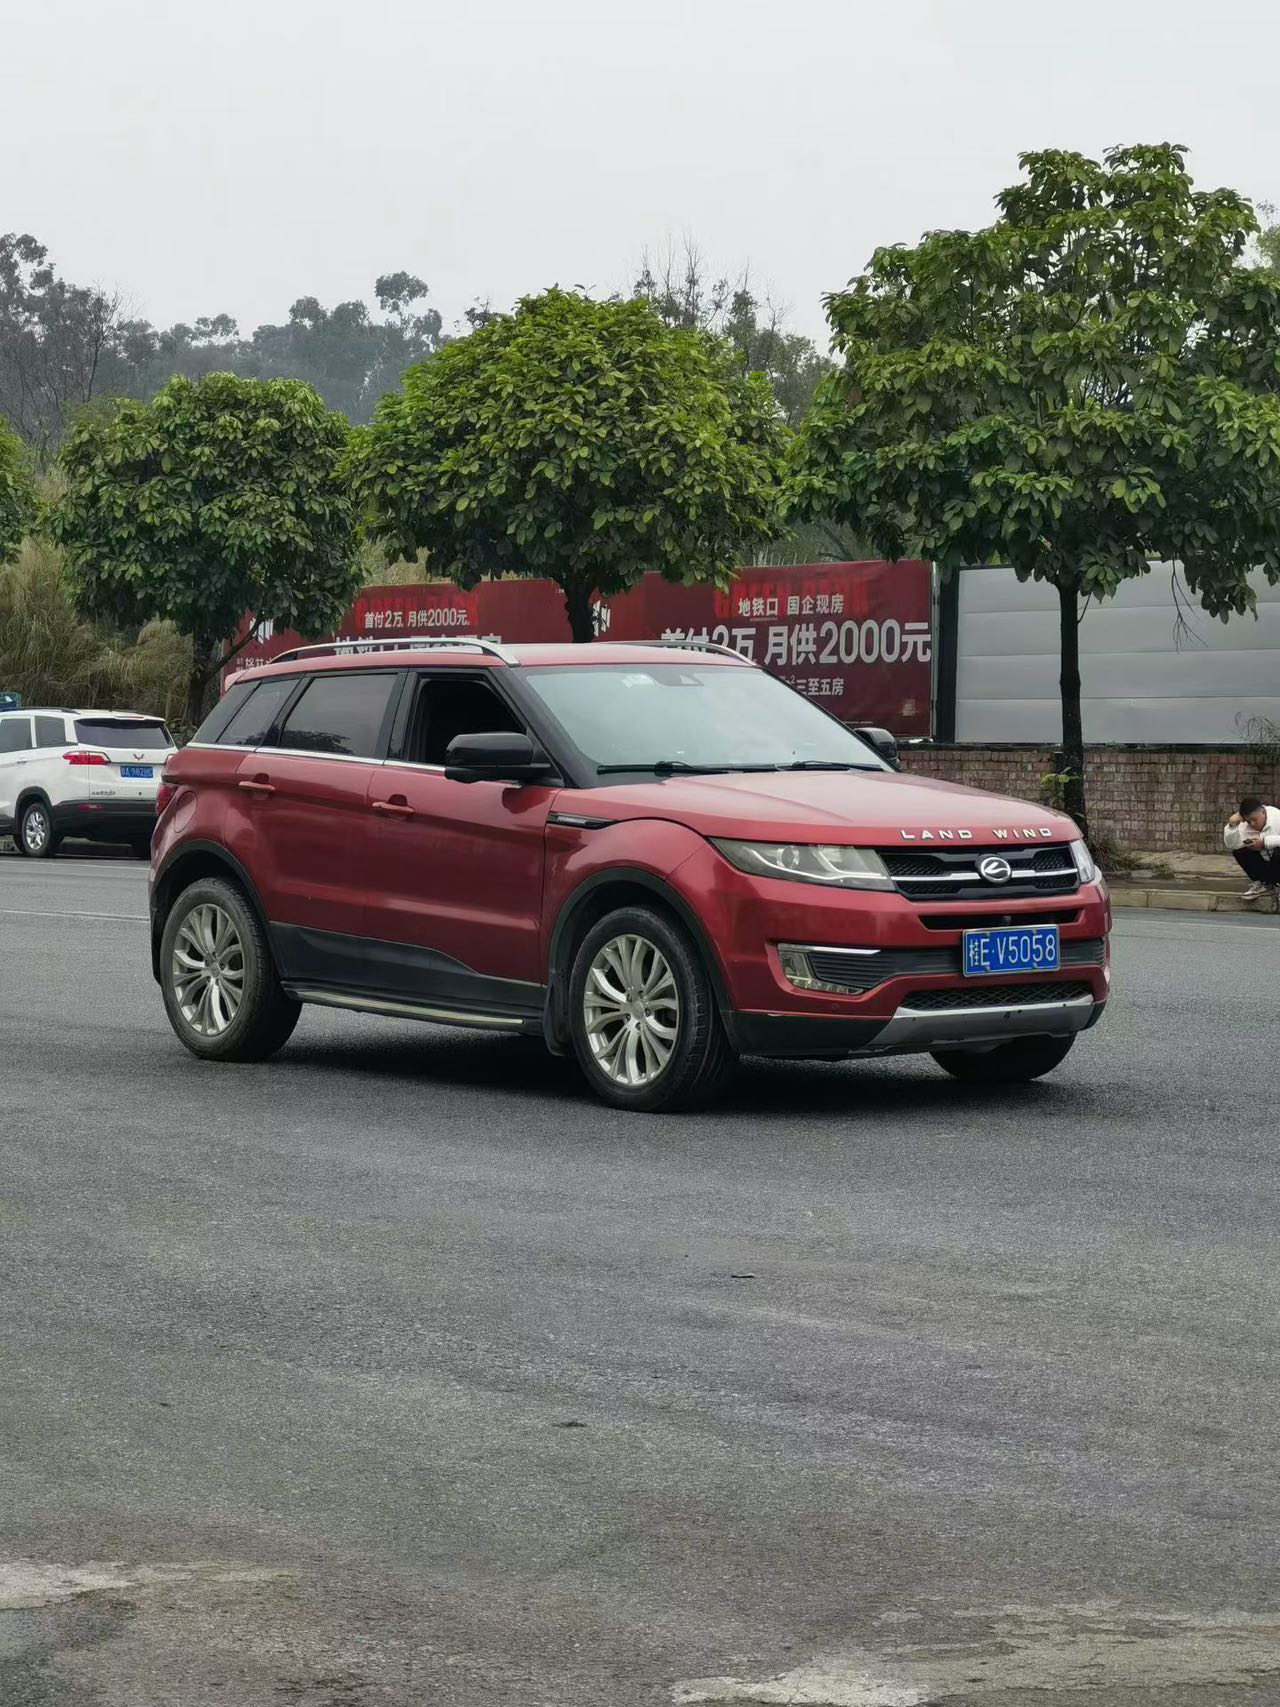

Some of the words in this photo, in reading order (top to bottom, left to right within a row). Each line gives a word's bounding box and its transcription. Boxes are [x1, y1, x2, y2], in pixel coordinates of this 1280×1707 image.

[738, 597, 779, 617] 地铁口
[787, 594, 844, 615] 国企现房
[764, 619, 932, 666] 月供2000元
[900, 829, 973, 840] LAND
[992, 828, 1053, 839] WIND
